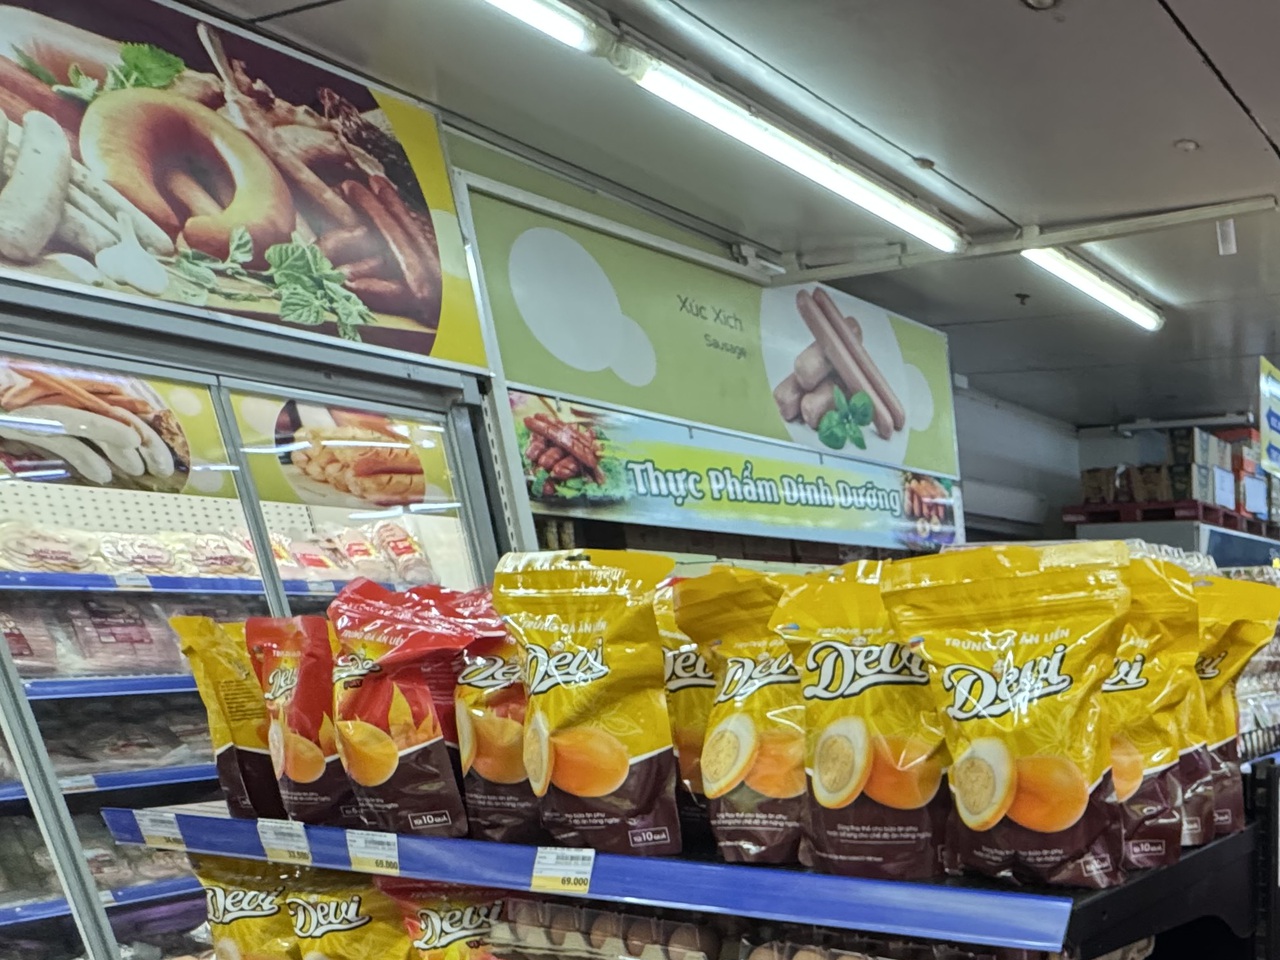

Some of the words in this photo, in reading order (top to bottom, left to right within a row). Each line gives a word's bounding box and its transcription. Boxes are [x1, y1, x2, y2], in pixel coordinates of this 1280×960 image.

[704, 333, 747, 359] Sausage
[626, 460, 704, 507] Thực
[706, 461, 780, 504] Phẩm
[836, 480, 902, 516] Dưỡng
[526, 637, 610, 695] Devi
[943, 644, 1073, 721] Devi
[422, 815, 434, 824] 10
[642, 832, 653, 841] 10
[561, 876, 588, 886] 69.000
[286, 896, 373, 938] Devi
[413, 900, 504, 950] Devi
